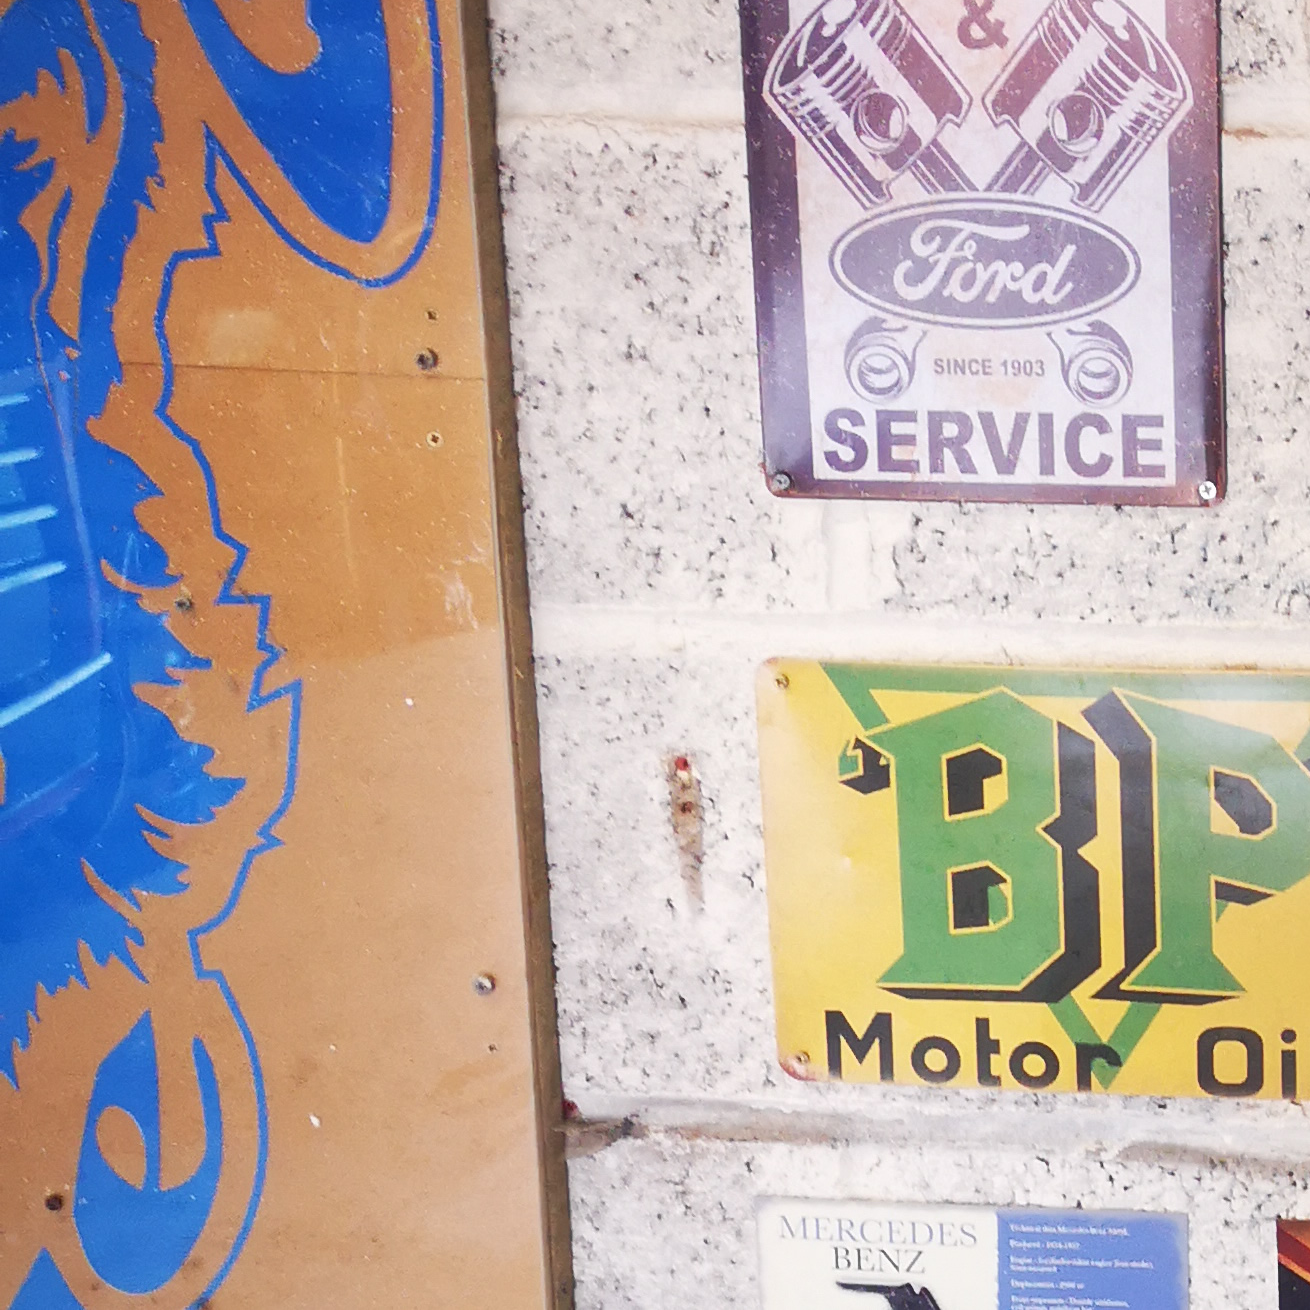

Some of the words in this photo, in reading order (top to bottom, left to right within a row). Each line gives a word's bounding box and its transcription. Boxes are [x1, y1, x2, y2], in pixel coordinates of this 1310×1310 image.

[892, 217, 1078, 305] Ford
[932, 356, 993, 378] SINCE
[999, 357, 1046, 378] 1903
[822, 406, 1167, 479] SERVICE
[823, 1009, 1123, 1092] Motor
[777, 1214, 978, 1247] MERCEDES
[832, 1245, 927, 1274] BENZ
